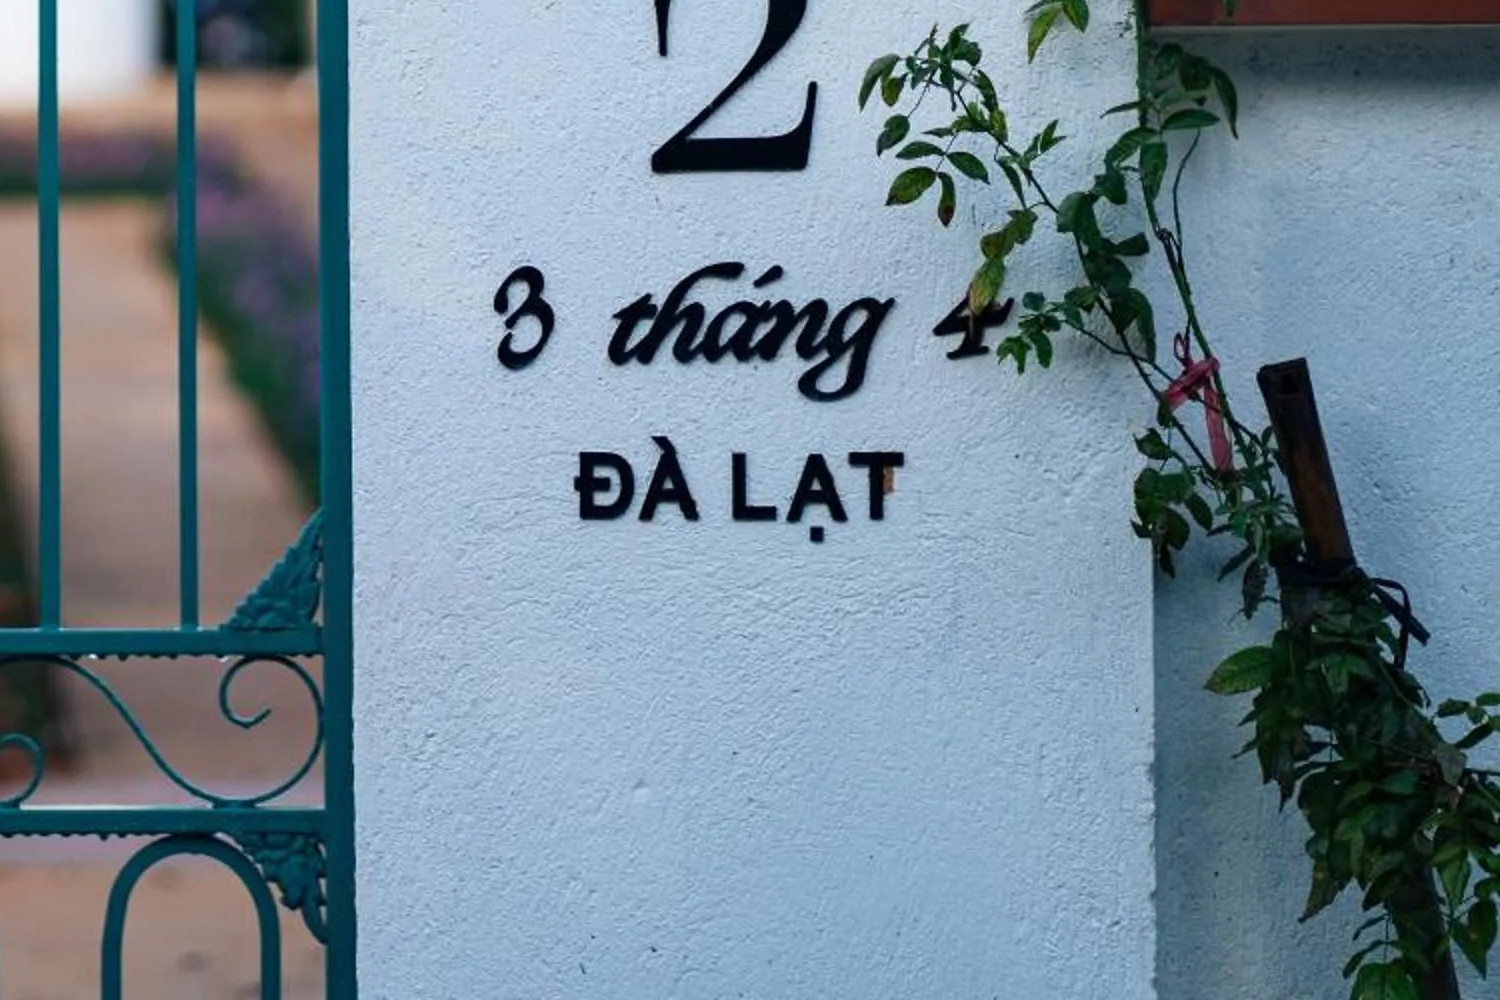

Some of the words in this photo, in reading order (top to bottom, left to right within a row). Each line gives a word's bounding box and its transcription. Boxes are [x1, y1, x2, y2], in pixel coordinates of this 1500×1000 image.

[493, 265, 556, 371] 3
[607, 261, 896, 402] tháng
[573, 435, 700, 523] ĐÀ
[731, 451, 905, 544] LẠT
